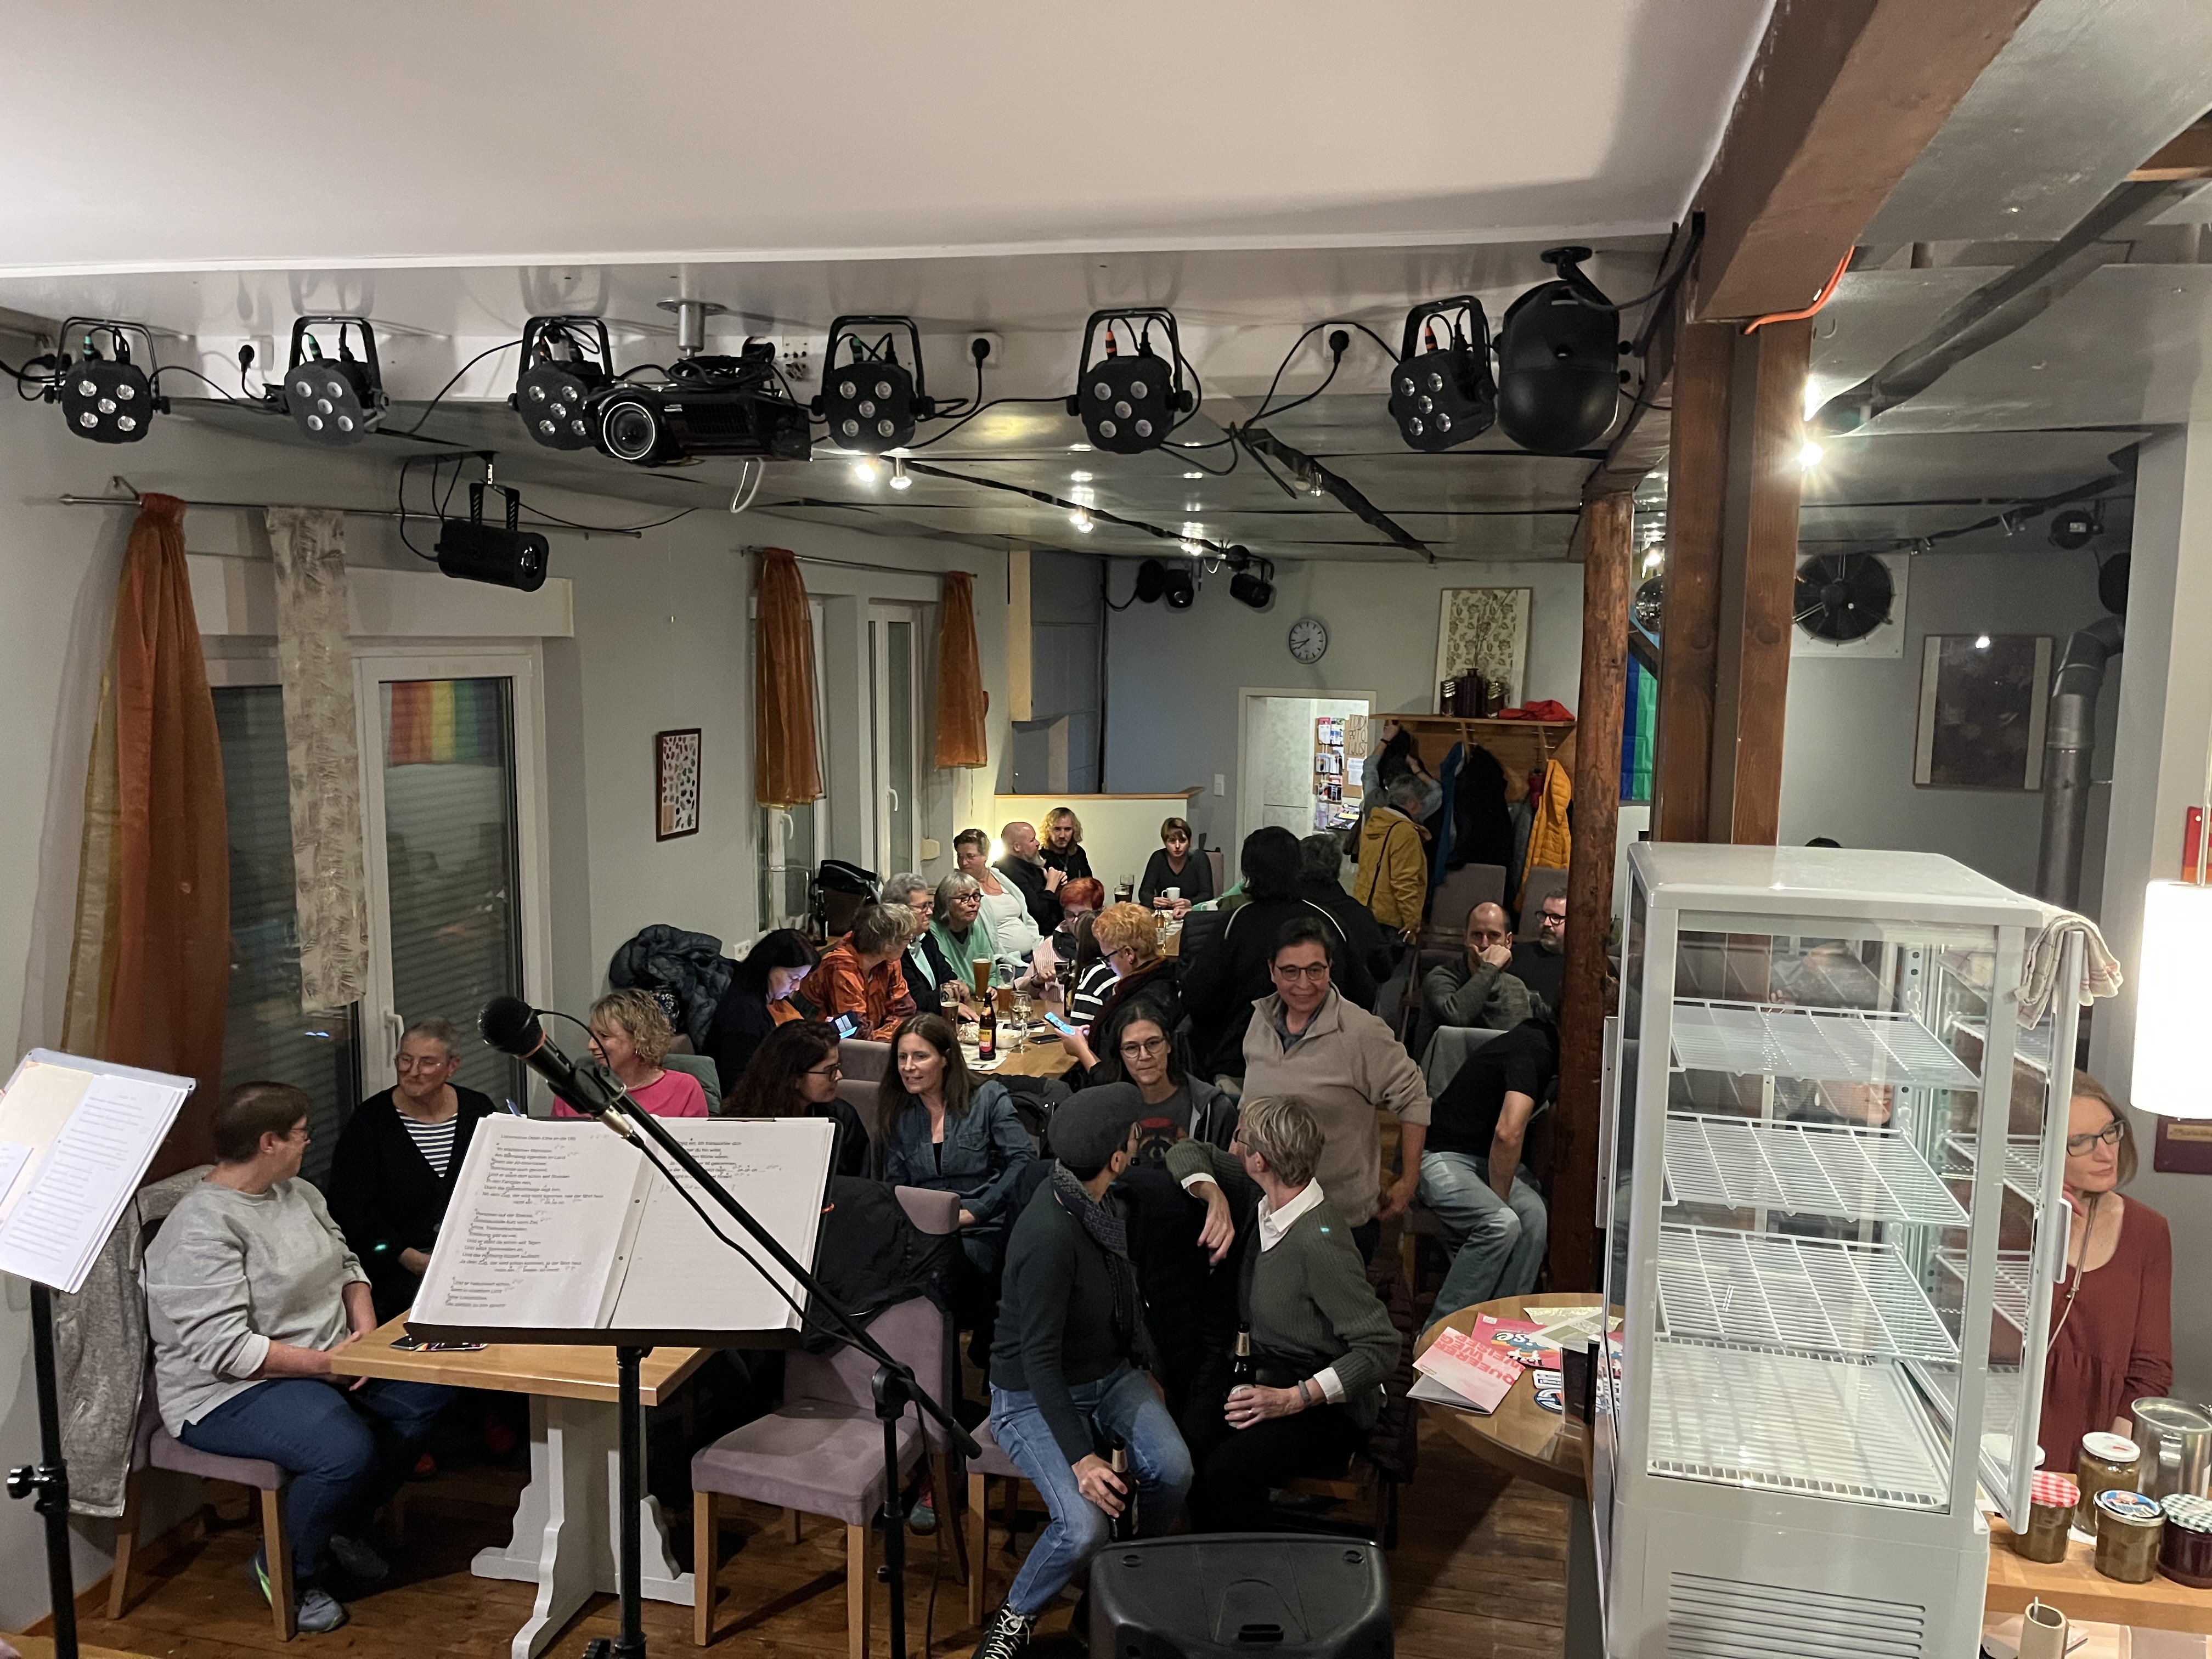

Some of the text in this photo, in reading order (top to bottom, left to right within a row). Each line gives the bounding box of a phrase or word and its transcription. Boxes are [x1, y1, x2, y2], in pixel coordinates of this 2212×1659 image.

[1434, 1341, 1516, 1386] QUEERER
[1438, 1334, 1483, 1362] WEG
[1454, 1334, 1526, 1372] WEISER
